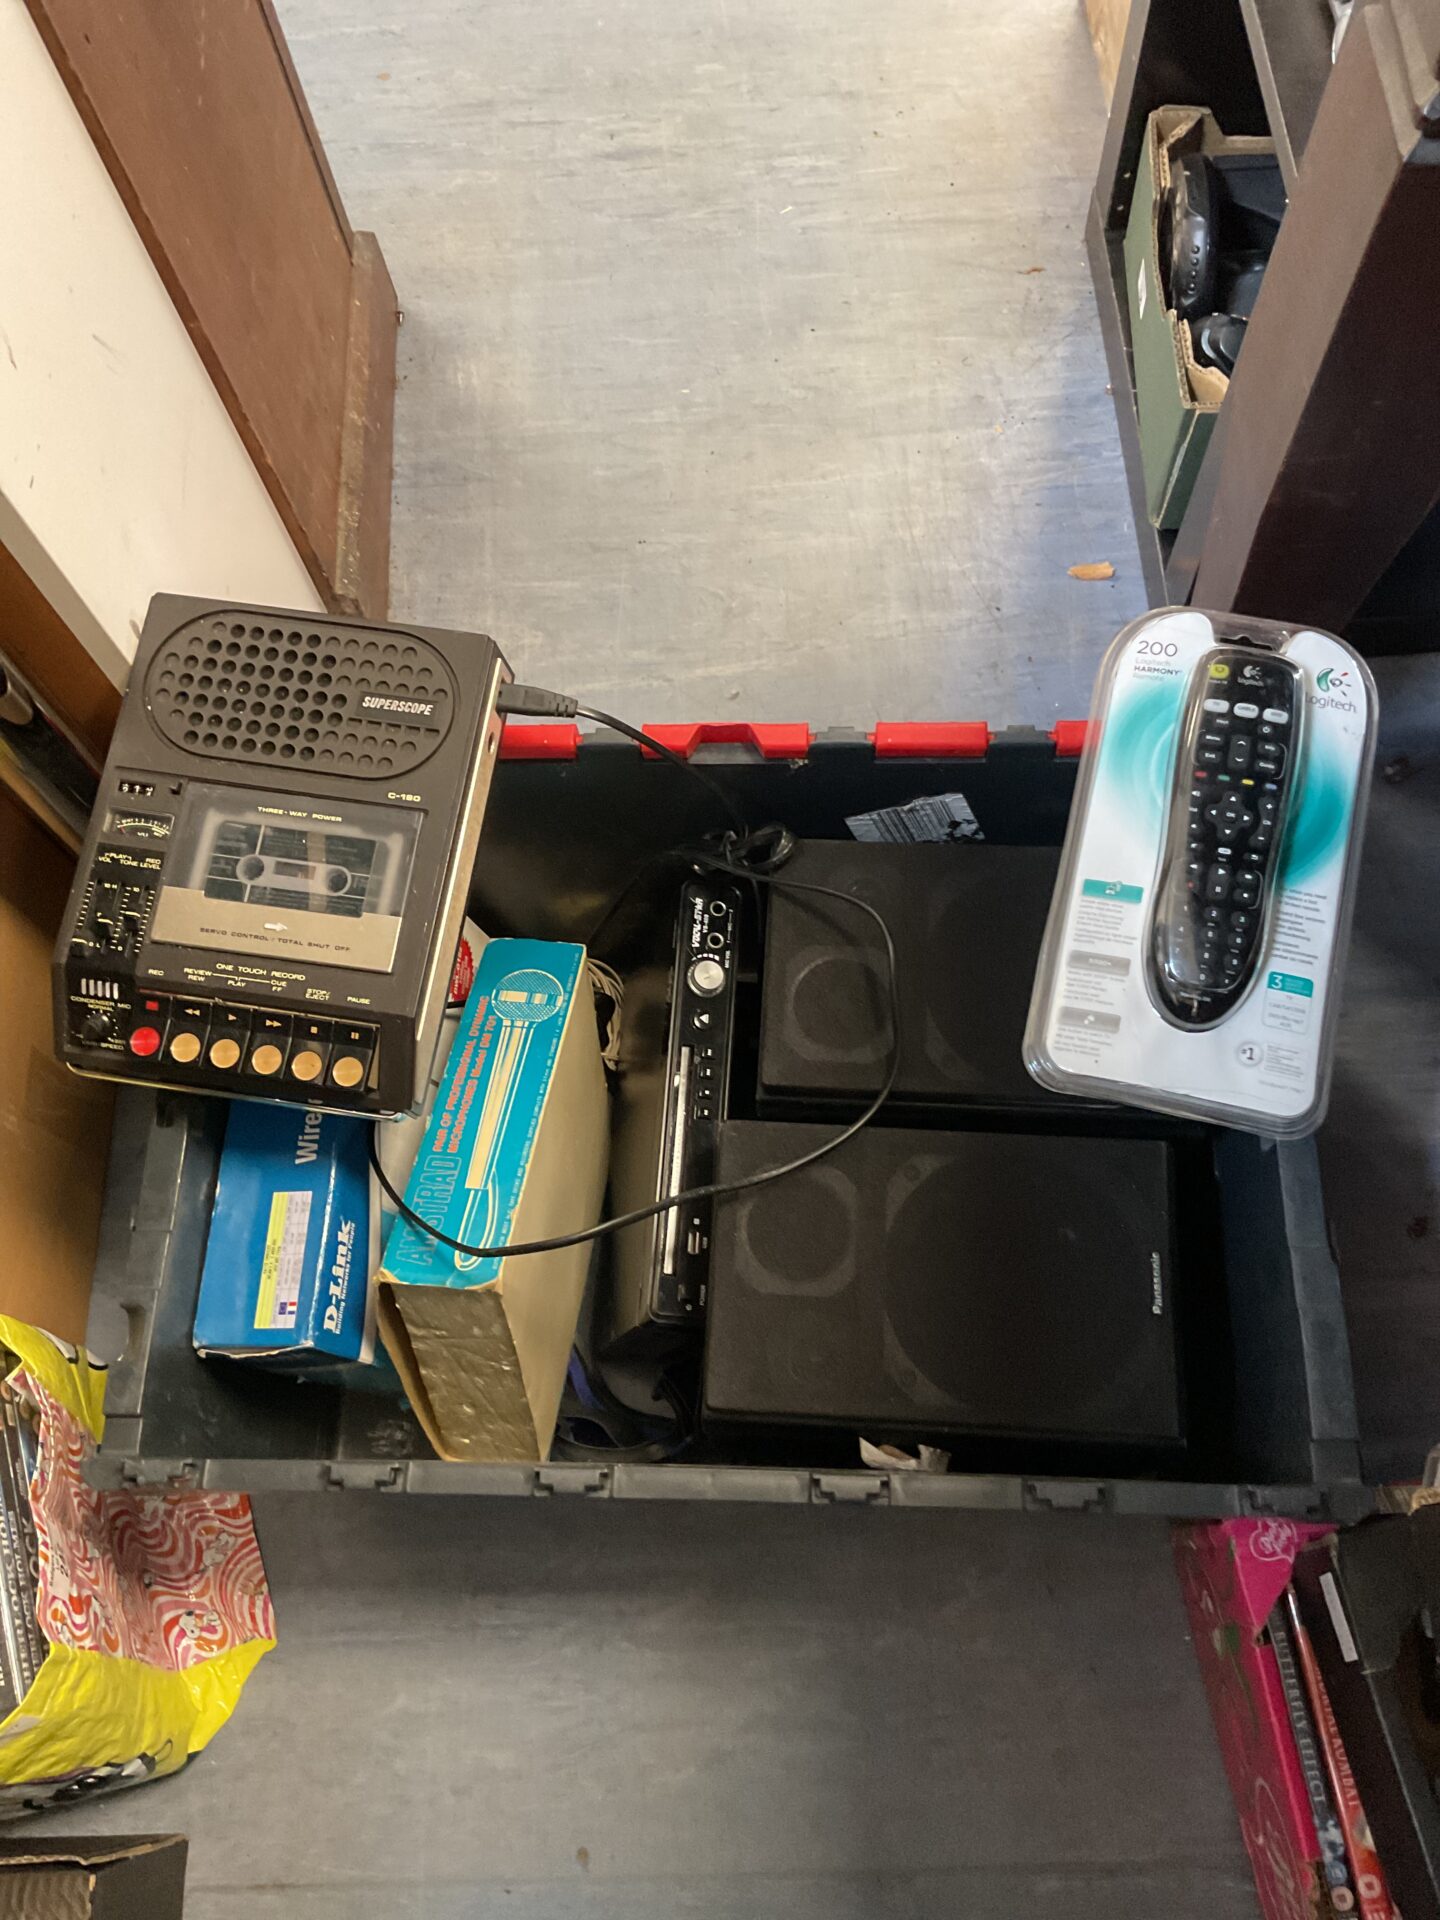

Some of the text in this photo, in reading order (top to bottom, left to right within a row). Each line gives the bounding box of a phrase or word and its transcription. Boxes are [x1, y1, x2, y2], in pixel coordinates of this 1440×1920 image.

[1137, 640, 1178, 657] 200
[1134, 665, 1181, 676] HARMONY
[362, 696, 434, 716] SUPERSCOPE
[1305, 692, 1357, 713] Logitech
[312, 812, 342, 823] POWER
[98, 856, 161, 870] VOL TONE LEVEL
[110, 852, 128, 860] PLAY
[146, 857, 161, 865] REC
[200, 928, 227, 937] SERVO
[231, 931, 269, 942] CONTROL
[278, 938, 303, 946] TOTAL
[307, 942, 330, 950] SHUT
[184, 968, 212, 977] REVIEW
[188, 974, 205, 982] REW
[216, 963, 306, 981] ONE TOUCH RECORD
[227, 980, 246, 988] PLAY
[271, 979, 287, 987] CUE
[1271, 974, 1283, 989] 3
[70, 995, 131, 1010] CONDENSER MIC
[305, 993, 330, 1001] EJECT
[347, 996, 370, 1005] PAUSE
[88, 1003, 114, 1011] NORMAL
[432, 995, 490, 1152] PAIR OF PROFESSIONAL DYNAMIC
[447, 1079, 478, 1153] MICROPHONES
[470, 1050, 487, 1077] Model
[484, 1015, 497, 1031] 701
[396, 1154, 462, 1266] AMSTRAD
[323, 1217, 351, 1333] D-Link
[1150, 1251, 1162, 1315] Panasonic
[1274, 1631, 1307, 1728] BUTTERFLY
[1300, 1738, 1326, 1801] EFFECT
